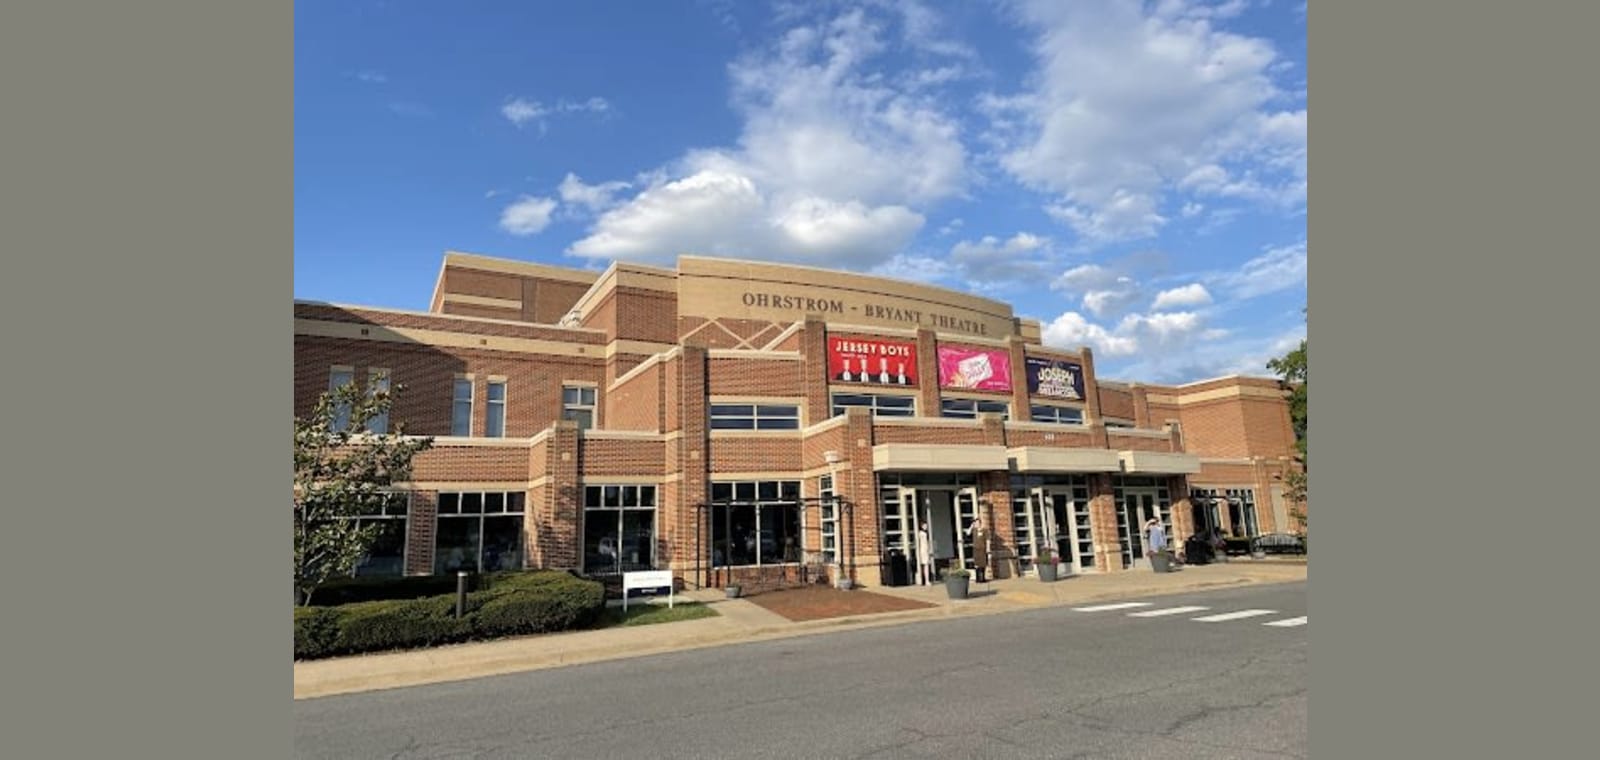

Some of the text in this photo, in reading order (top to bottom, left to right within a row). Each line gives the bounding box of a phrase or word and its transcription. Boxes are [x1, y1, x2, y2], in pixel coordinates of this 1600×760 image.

[742, 292, 844, 314] OHRSTROM
[865, 304, 923, 324] BRYANT
[930, 313, 988, 335] THEATRE
[835, 340, 877, 354] JERSEY
[880, 344, 910, 356] BOYS
[1037, 367, 1075, 385] JOSEPH
